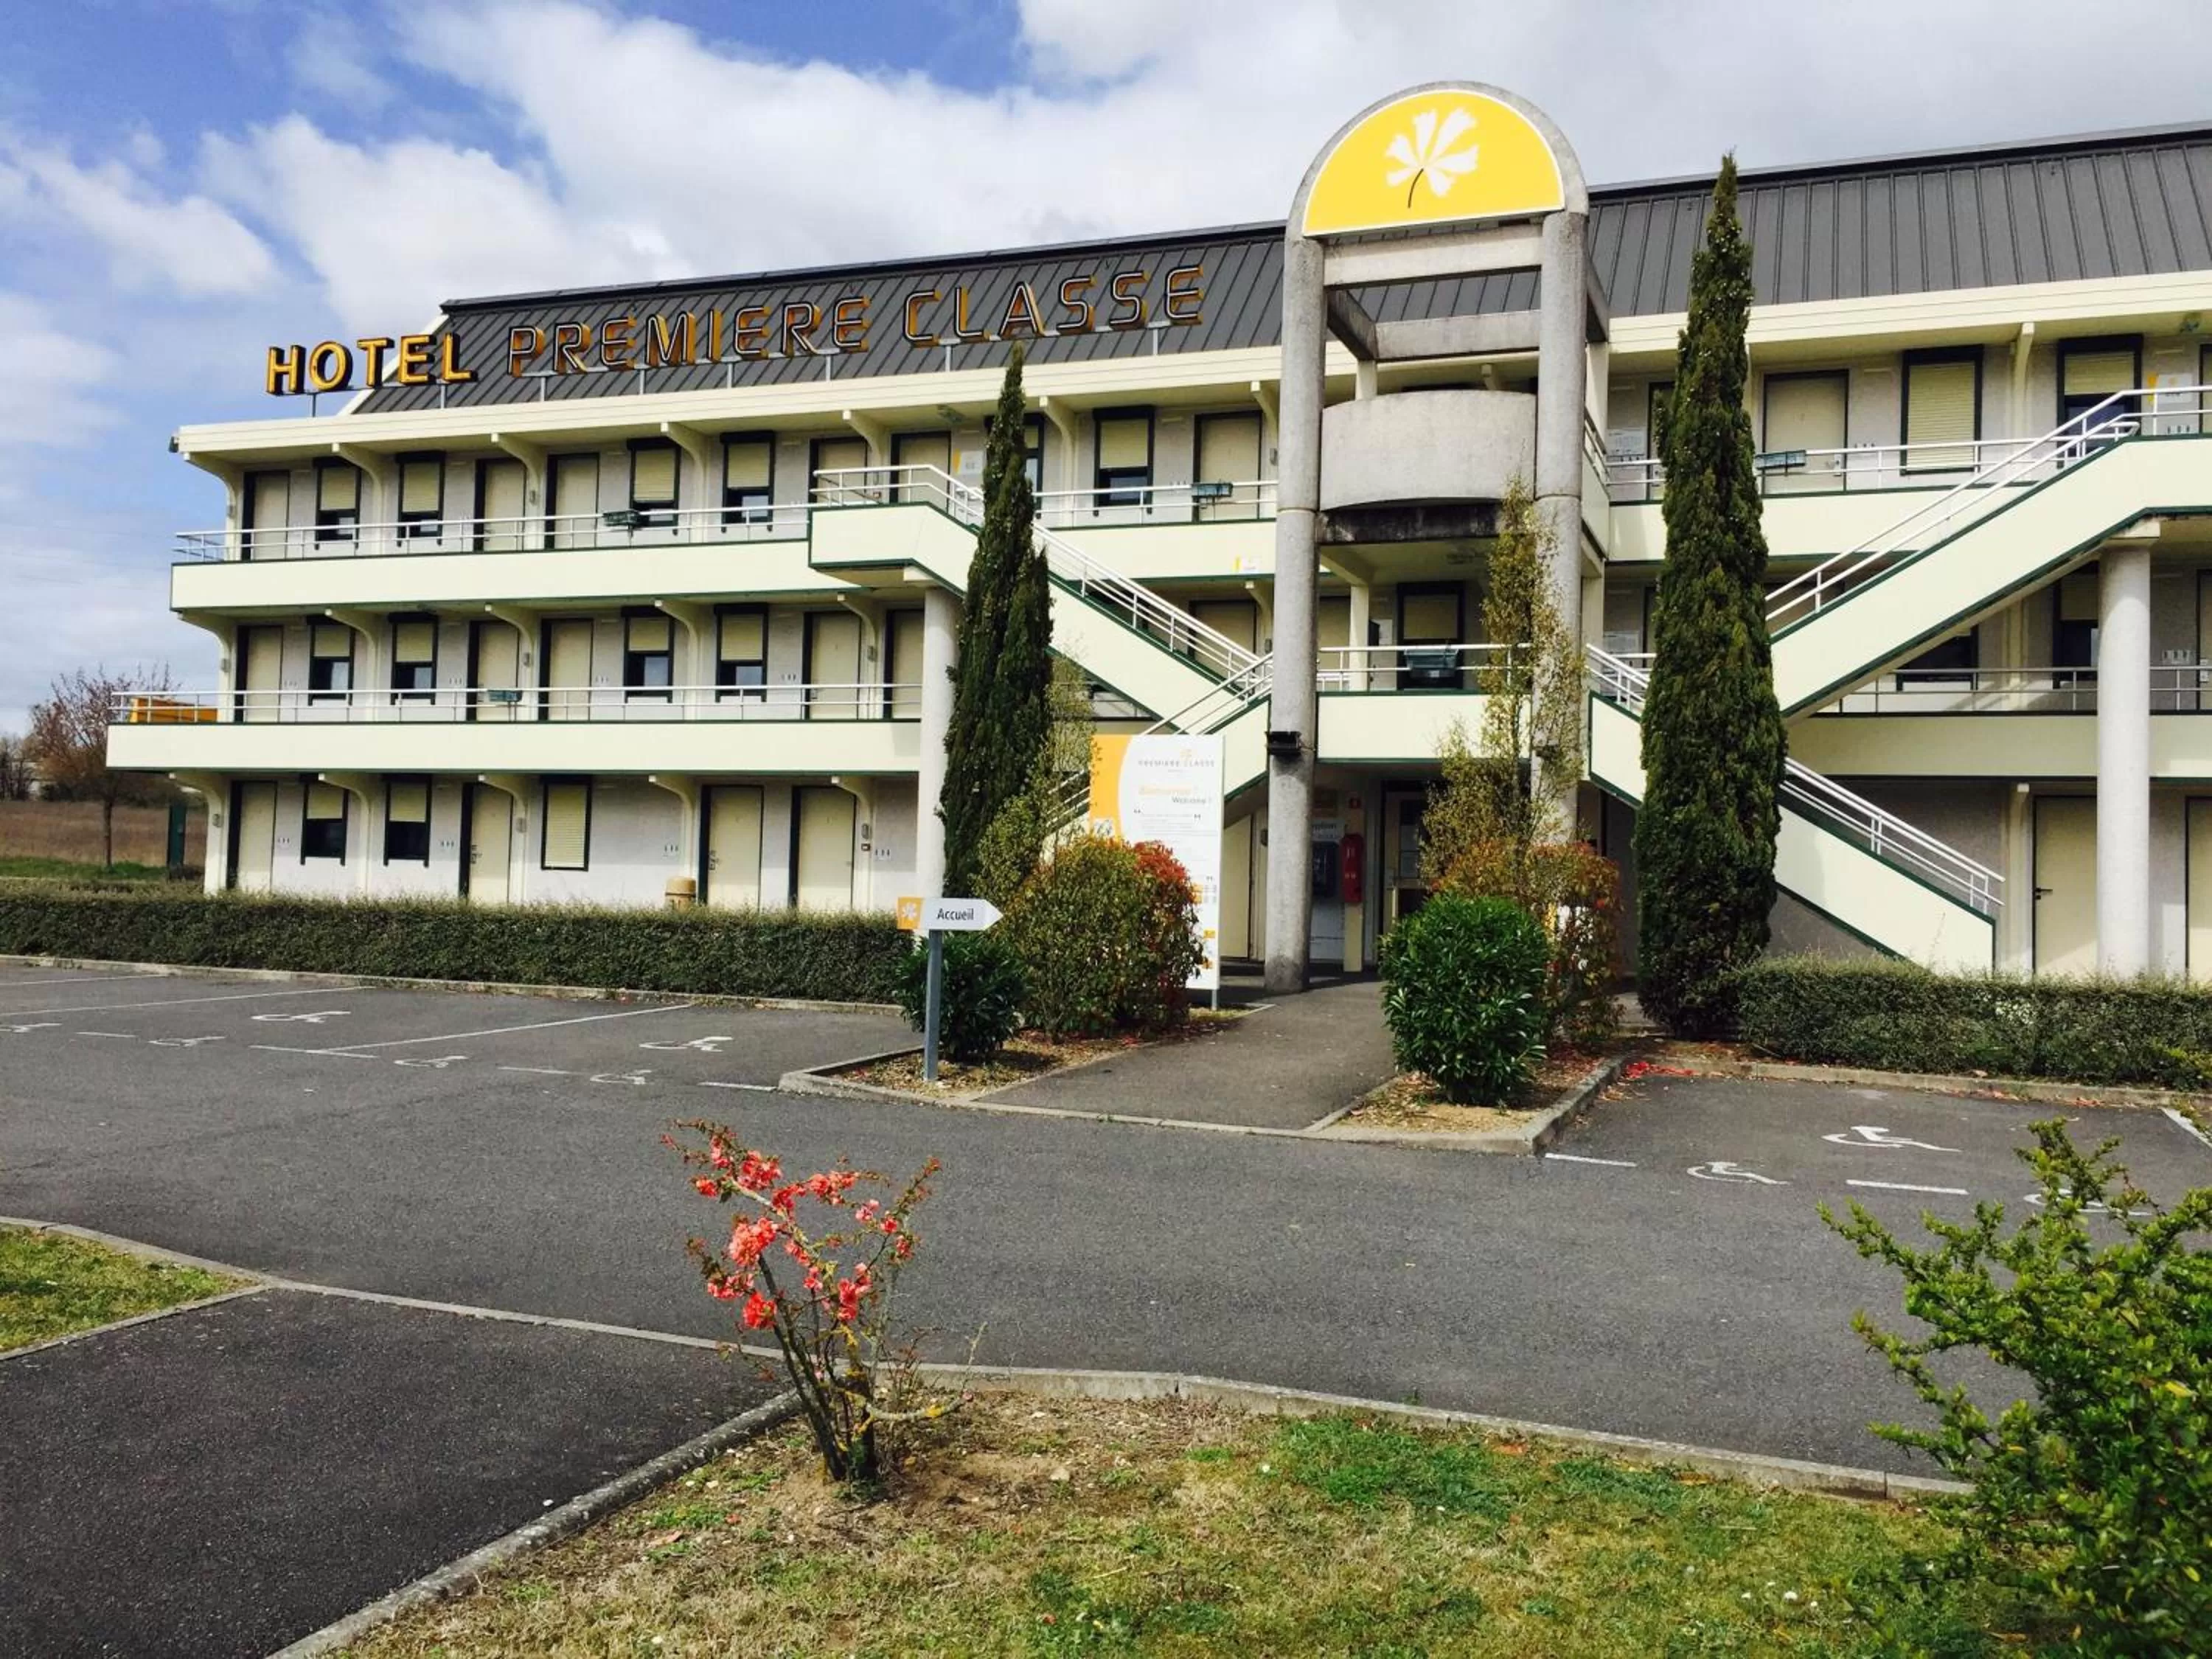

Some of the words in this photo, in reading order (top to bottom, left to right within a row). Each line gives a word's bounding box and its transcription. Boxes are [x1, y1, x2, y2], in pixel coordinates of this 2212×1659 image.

[266, 332, 478, 394] HOTEL
[508, 296, 869, 377] PREMIERE
[904, 264, 1203, 347] CLASSE
[936, 908, 974, 920] Accueil
